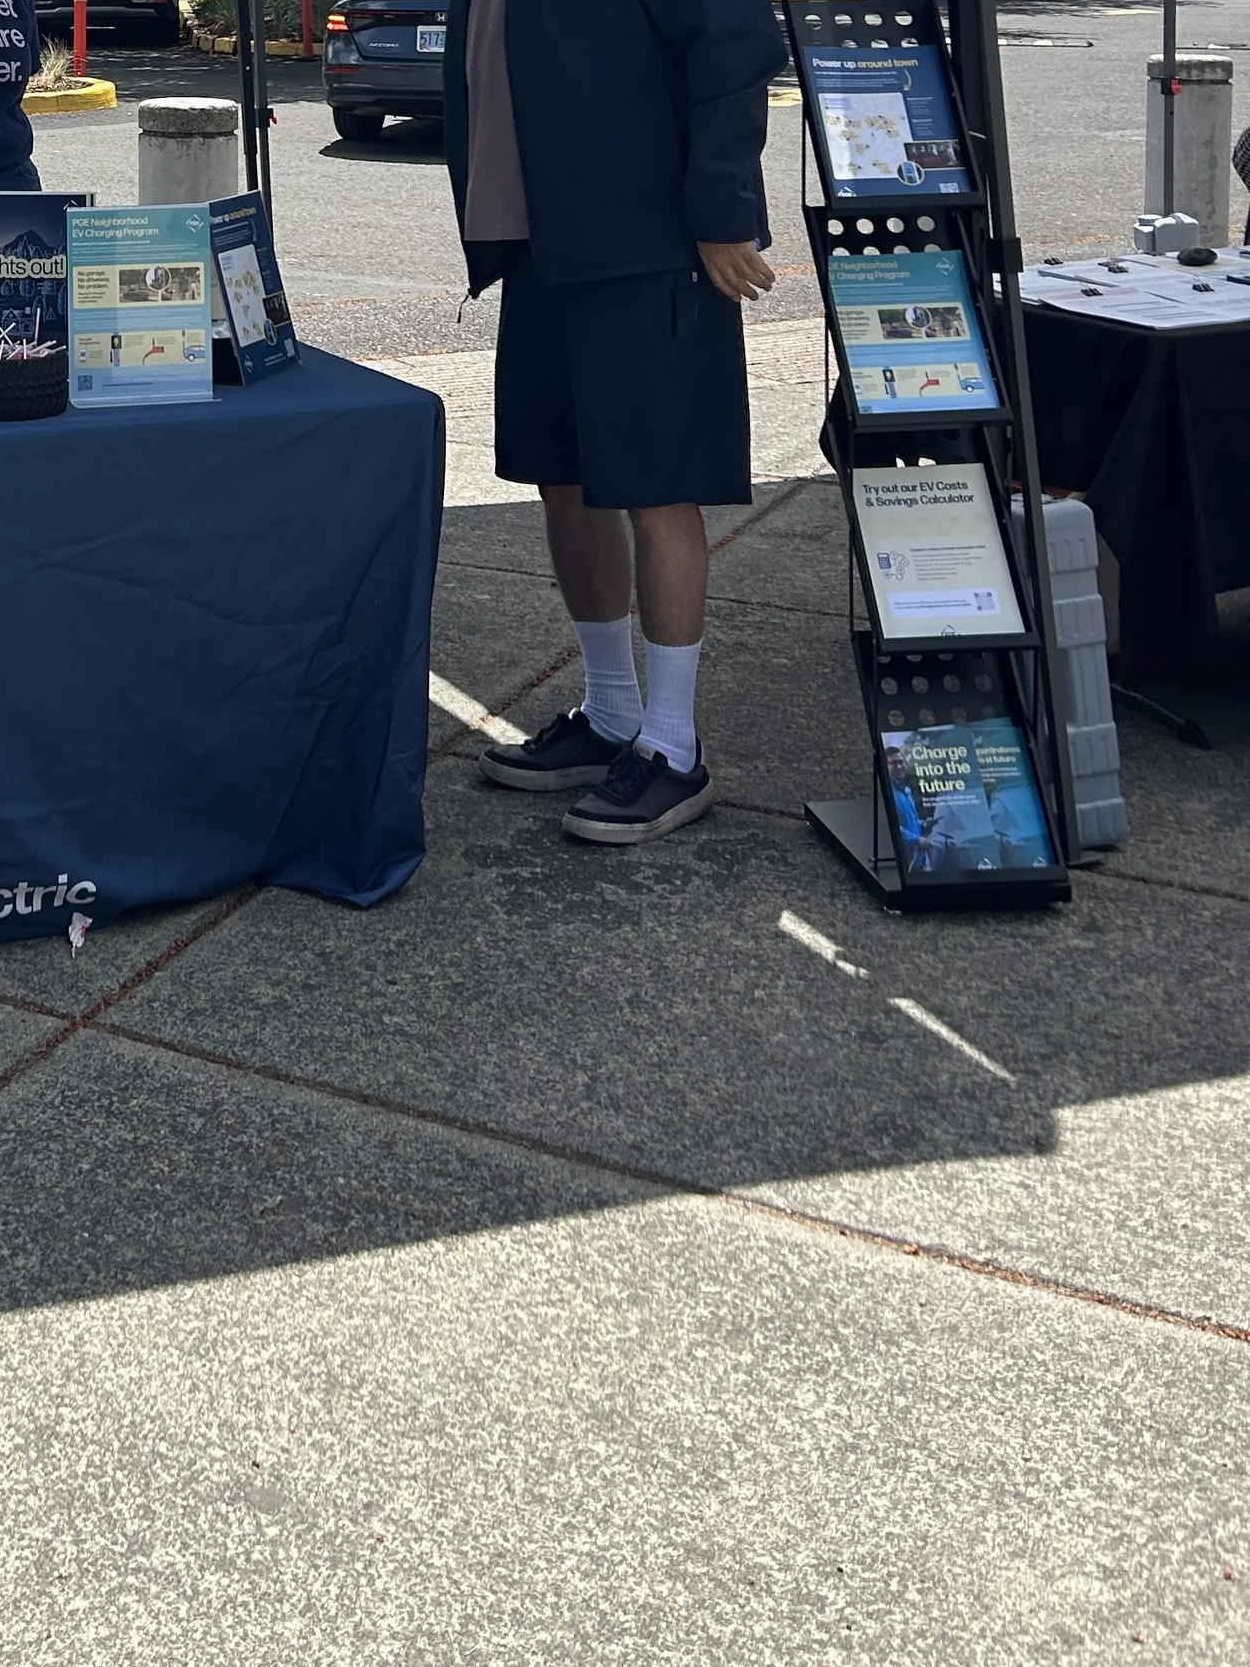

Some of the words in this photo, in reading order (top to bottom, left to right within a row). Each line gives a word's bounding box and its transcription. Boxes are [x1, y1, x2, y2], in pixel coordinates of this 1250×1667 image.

[812, 58, 842, 68] Power
[843, 61, 857, 69] up
[857, 59, 892, 68] around
[893, 59, 919, 67] town
[72, 218, 90, 227] PGE
[90, 217, 148, 228] Neighborhood
[72, 229, 84, 238] EV
[85, 229, 122, 239] Charging
[123, 228, 159, 238] Program
[31, 257, 64, 275] out!
[862, 485, 879, 495] Try
[881, 484, 899, 493] out
[901, 484, 918, 492] our
[919, 482, 934, 491] EV
[936, 481, 968, 490] Costs
[865, 497, 875, 507] &
[876, 496, 919, 508] Savings
[920, 494, 975, 505] Calculator
[912, 746, 968, 761] Charge
[915, 763, 944, 777] into
[946, 761, 971, 774] the
[918, 779, 966, 793] future
